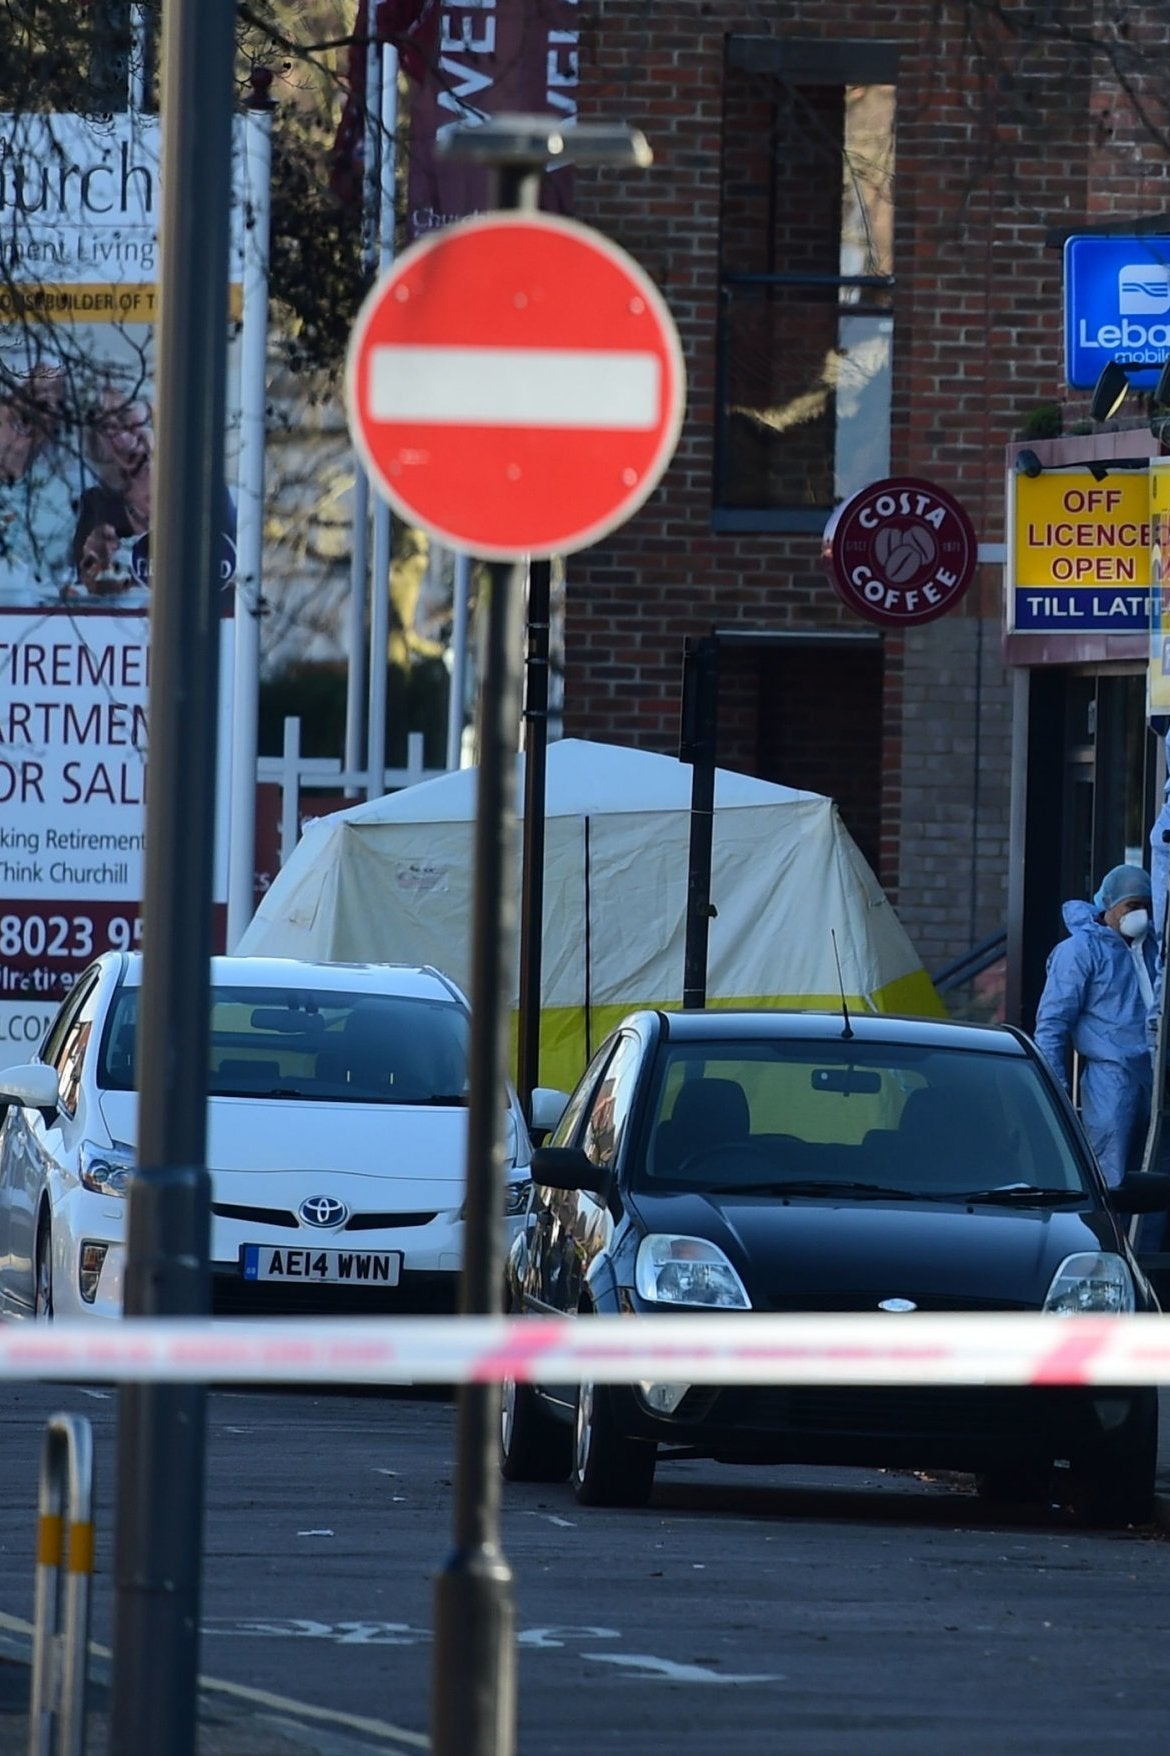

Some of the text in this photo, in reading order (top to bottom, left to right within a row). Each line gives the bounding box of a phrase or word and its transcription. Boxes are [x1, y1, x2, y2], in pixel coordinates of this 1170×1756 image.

[77, 234, 154, 271] Living
[119, 294, 141, 311] OF
[858, 492, 947, 530] COSTA
[1063, 489, 1122, 513] OFF
[1052, 557, 1135, 580] OPEN
[851, 565, 958, 612] COFFEE
[1026, 597, 1085, 617] TILL
[62, 762, 147, 804] SAL
[50, 862, 128, 884] Churchill
[268, 1250, 389, 1280] AE14 WWN
